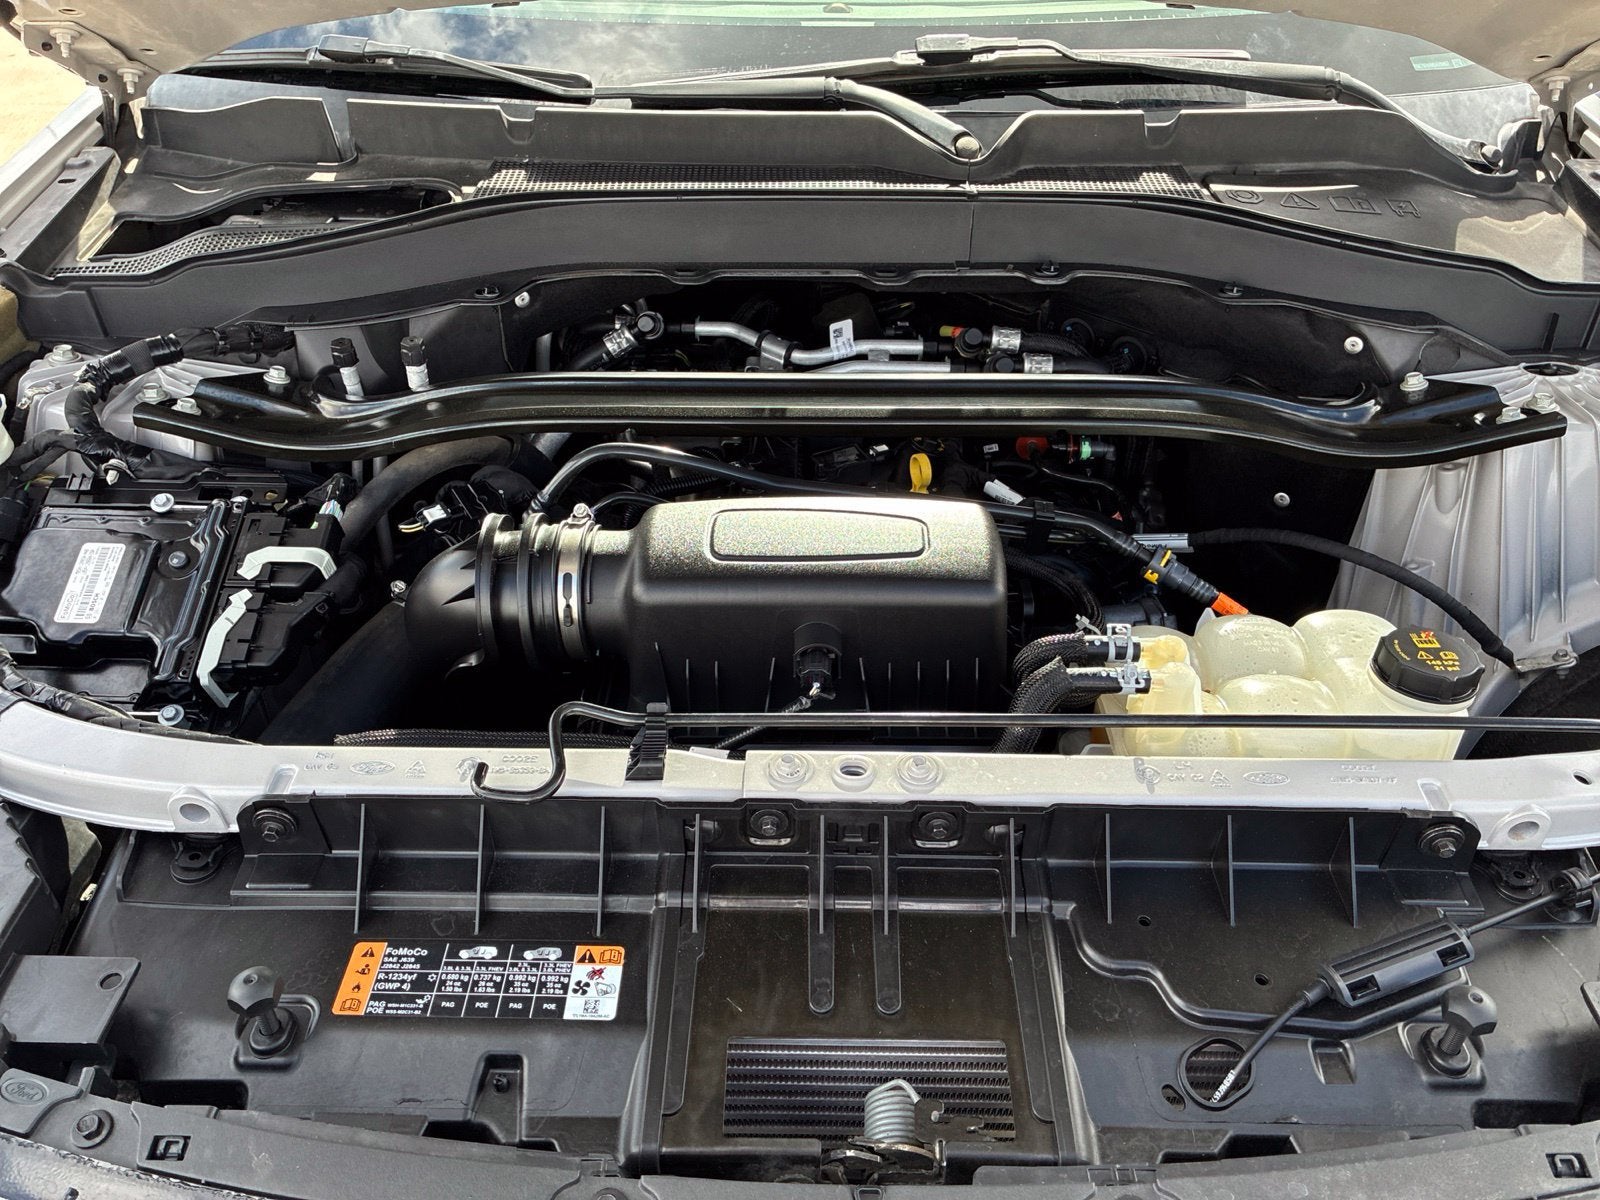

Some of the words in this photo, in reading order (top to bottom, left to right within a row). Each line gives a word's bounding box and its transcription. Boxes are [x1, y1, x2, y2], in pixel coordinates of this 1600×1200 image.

[60, 593, 75, 619] FoMoCo
[89, 593, 100, 611] BOSCH
[385, 947, 428, 956] FoMoCo
[377, 972, 418, 982] R-1234yf
[460, 973, 469, 982] kg
[492, 974, 501, 982] kg
[527, 974, 536, 983] kg
[560, 975, 569, 984] kg
[374, 982, 400, 991] (GWP
[401, 982, 411, 991] 4)
[11, 1082, 39, 1101] Ford
